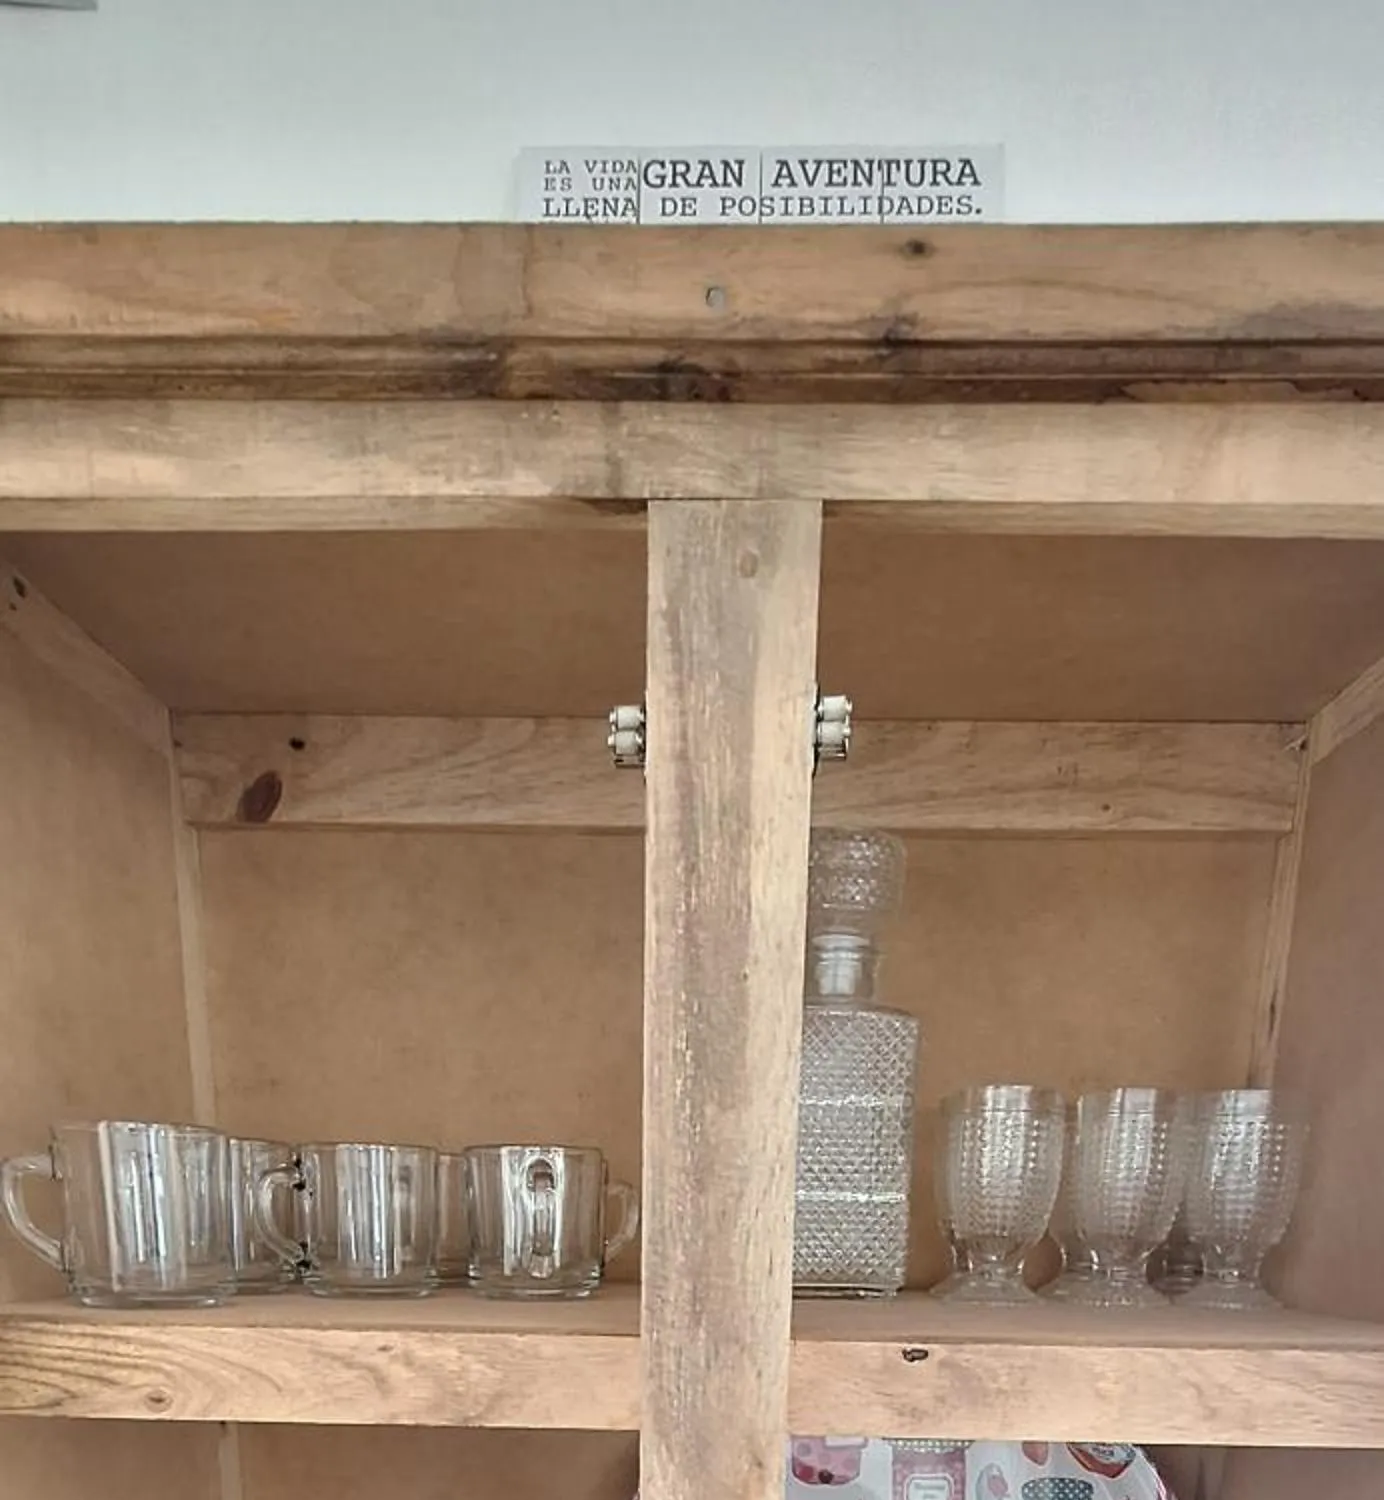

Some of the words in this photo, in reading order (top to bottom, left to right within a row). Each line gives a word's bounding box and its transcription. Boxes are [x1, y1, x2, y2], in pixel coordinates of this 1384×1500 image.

[544, 159, 571, 174] LA
[584, 159, 638, 174] VIDA
[643, 159, 745, 189] GRAN
[771, 158, 982, 188] AVENTURA
[543, 177, 572, 192] ES
[591, 177, 638, 192] UNA
[542, 197, 639, 219] LLENA
[660, 197, 698, 217] DE
[719, 195, 983, 217] POSIBILIDADES.
